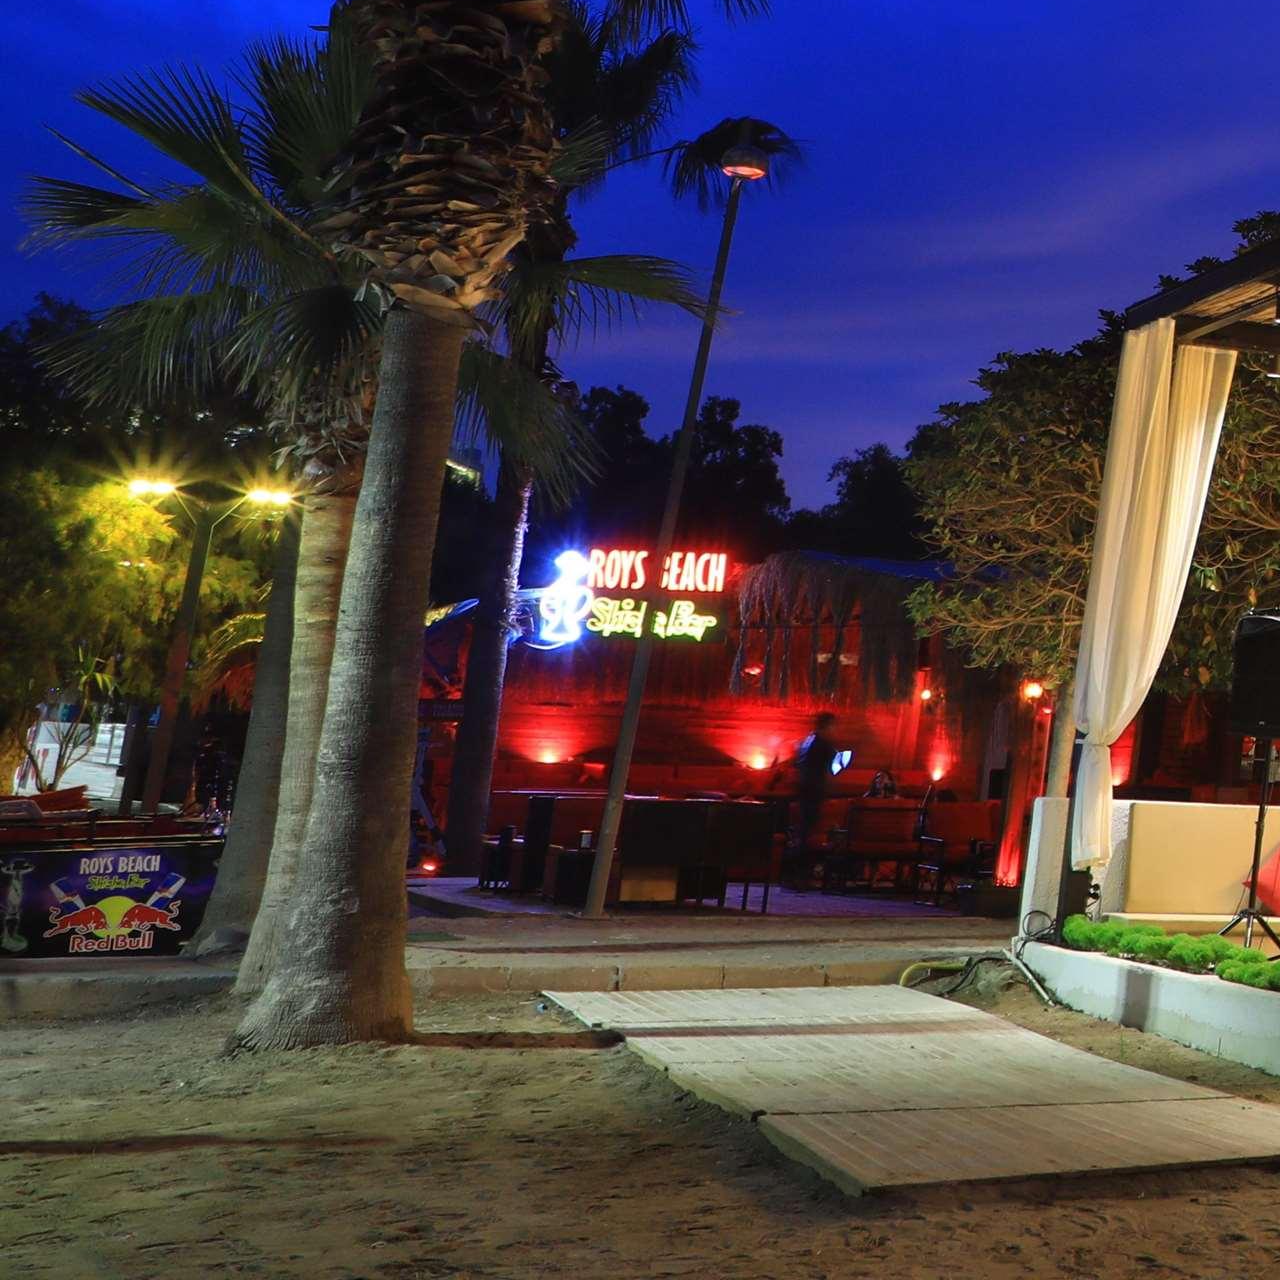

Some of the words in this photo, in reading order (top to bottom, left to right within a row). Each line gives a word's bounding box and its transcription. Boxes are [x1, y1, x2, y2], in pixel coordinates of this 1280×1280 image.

[588, 549, 649, 590] ROYS
[79, 856, 114, 875] ROYS
[118, 854, 161, 873] BEACH
[69, 934, 111, 953] Red
[112, 931, 154, 951] Bull
